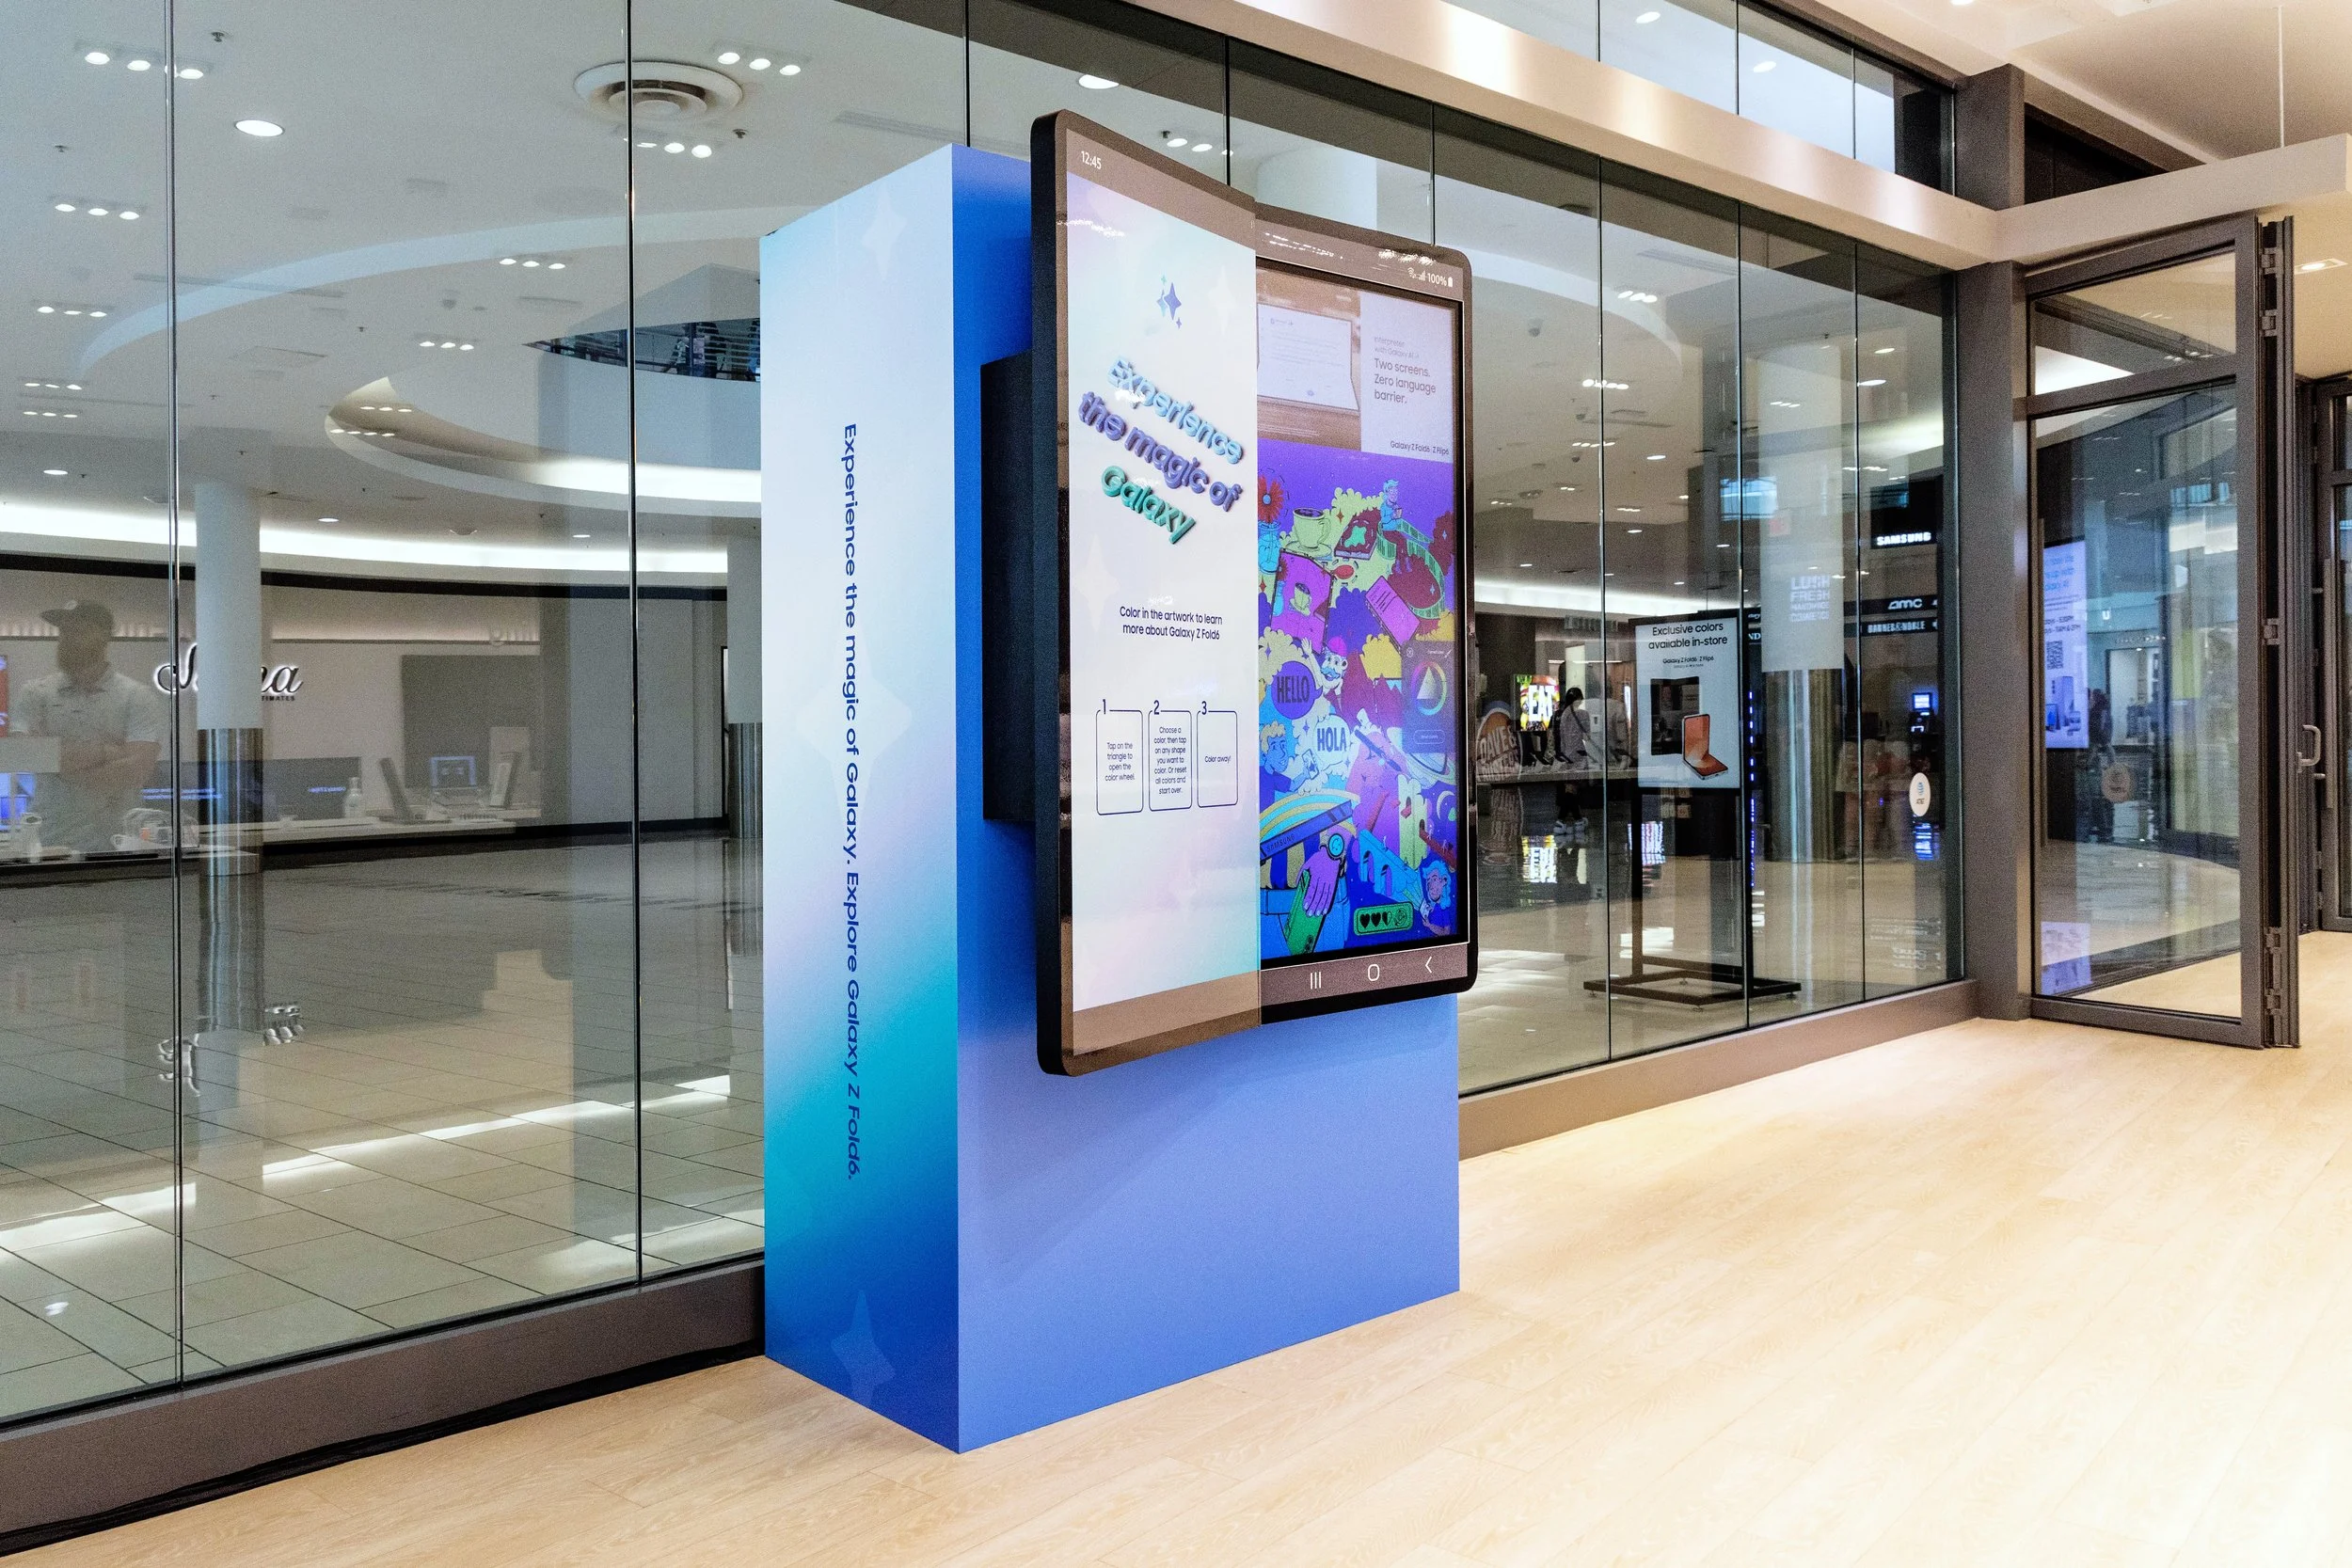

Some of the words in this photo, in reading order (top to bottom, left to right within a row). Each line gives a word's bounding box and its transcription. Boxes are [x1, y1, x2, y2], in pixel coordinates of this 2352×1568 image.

[1081, 150, 1102, 169] 12:45
[1427, 273, 1447, 286] 100%
[1374, 357, 1392, 371] Two
[1394, 363, 1431, 377] screens.
[1374, 373, 1393, 386] Zero
[1396, 377, 1436, 395] language
[1374, 388, 1407, 404] barrier.
[1107, 356, 1244, 465] Experience
[1078, 391, 1127, 441] the
[1124, 426, 1210, 495] magic
[1209, 481, 1244, 512] of
[1390, 440, 1411, 451] Galaxy
[841, 423, 858, 577] Experience
[1101, 465, 1197, 545] Galaxy
[1876, 531, 1931, 546] SAMSUNG
[845, 582, 858, 629] the
[1120, 606, 1141, 618] Color
[1141, 607, 1150, 619] in
[1150, 609, 1164, 621] the
[1164, 610, 1195, 624] artwork
[1196, 613, 1203, 624] to
[1203, 613, 1223, 626] learn
[1122, 624, 1144, 635] more
[1145, 625, 1168, 637] about
[1168, 626, 1195, 641] Galaxy
[1196, 628, 1201, 639] Z
[1201, 628, 1220, 641] Fold6
[1652, 624, 1693, 636] Exclusive
[1694, 623, 1724, 633] colors
[1648, 638, 1691, 649] available
[1692, 636, 1728, 646] in-store
[842, 635, 859, 721] magic
[1276, 674, 1311, 705] HELLO
[1103, 699, 1106, 715] 1
[1153, 700, 1160, 715] 2
[1201, 701, 1207, 715] 3
[1528, 684, 1556, 722] EAT
[846, 727, 860, 756] of
[1106, 742, 1117, 751] Tap
[1316, 726, 1347, 752] HOLA
[1106, 752, 1127, 762] triangle
[1171, 747, 1186, 755] shape
[1108, 764, 1121, 772] open
[843, 762, 858, 865] Galaxy.
[1266, 833, 1295, 852] SAMSUNG
[843, 872, 859, 973] Explore
[843, 978, 860, 1077] Galaxy
[848, 1084, 860, 1100] Z
[847, 1104, 861, 1181] Fold6.
